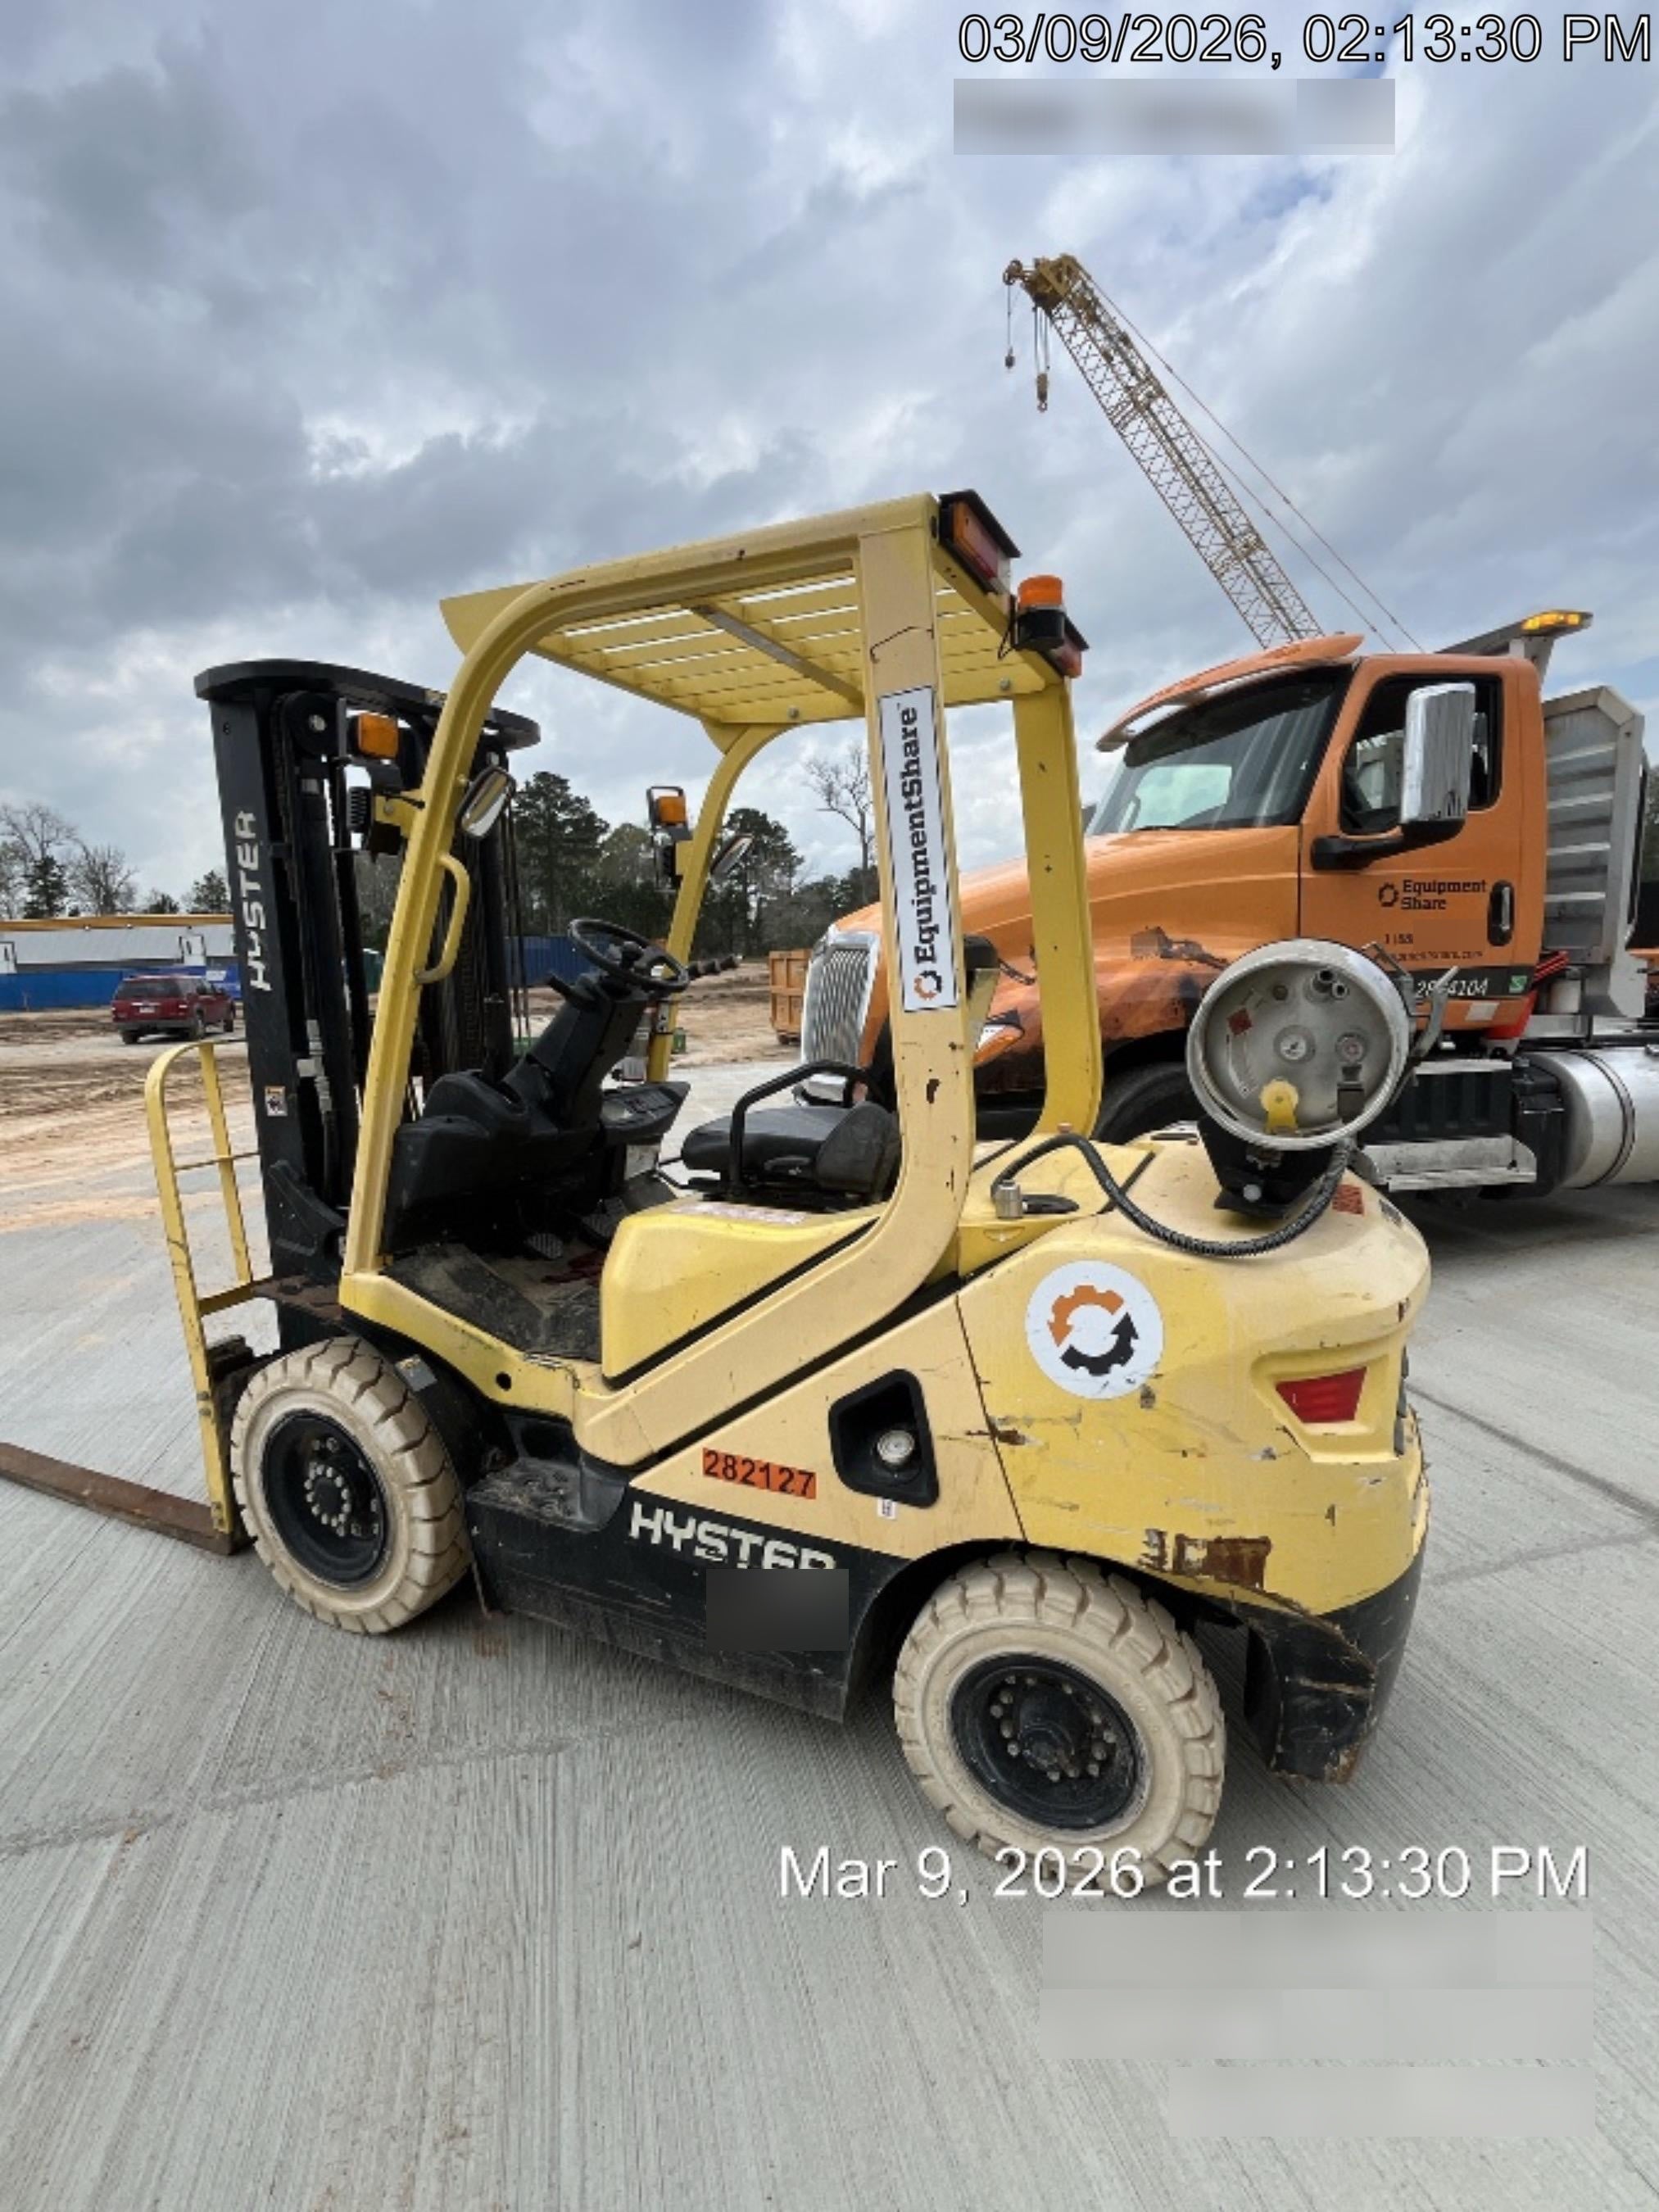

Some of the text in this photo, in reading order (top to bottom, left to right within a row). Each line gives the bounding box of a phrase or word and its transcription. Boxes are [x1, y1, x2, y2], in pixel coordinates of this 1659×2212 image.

[900, 707, 940, 964] EquipmentShare
[234, 810, 272, 992] HYSTER
[1400, 896, 1447, 909] Share
[1402, 879, 1486, 895] Equipment
[705, 1450, 814, 1496] 282127
